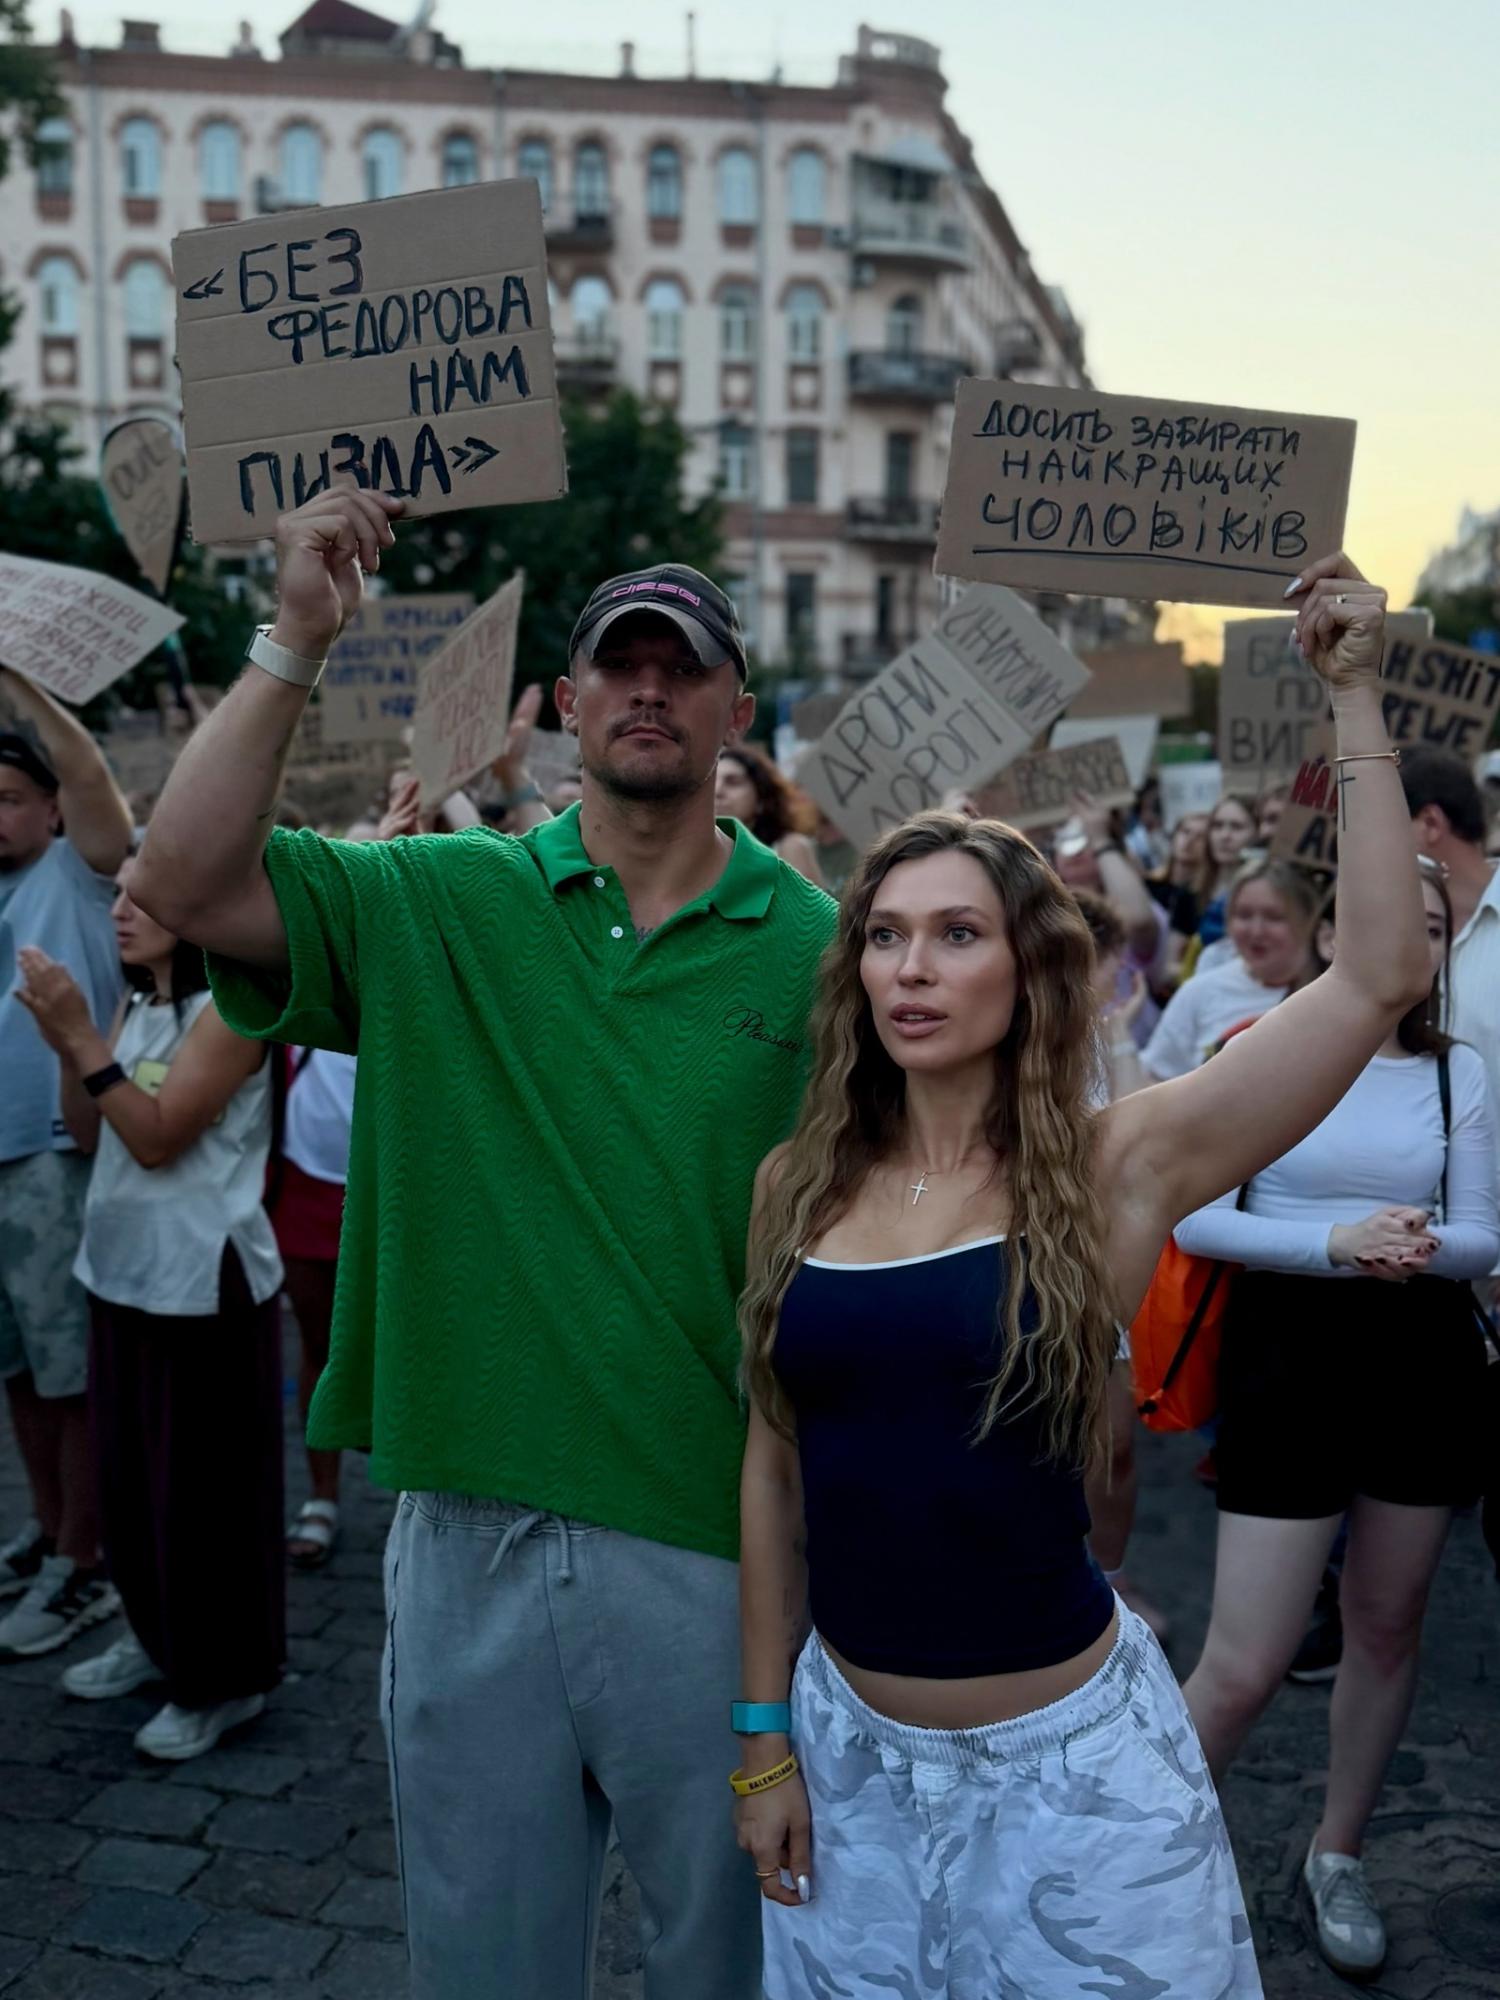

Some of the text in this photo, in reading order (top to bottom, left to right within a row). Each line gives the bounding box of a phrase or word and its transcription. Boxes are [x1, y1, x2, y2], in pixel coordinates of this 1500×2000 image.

[268, 275, 532, 364] ФЕДОРОВА
[409, 345, 531, 416] НАМ
[972, 399, 1299, 456] ДОСИТЬ ЗАБИРАТИ
[1002, 443, 1285, 495] НАЙКРАЩИХ
[983, 493, 1308, 559] ЧОЛОВІКІВ
[1274, 676, 1325, 711] ПО
[818, 653, 950, 809] ДРОНИ
[1229, 714, 1317, 766] ВИГ
